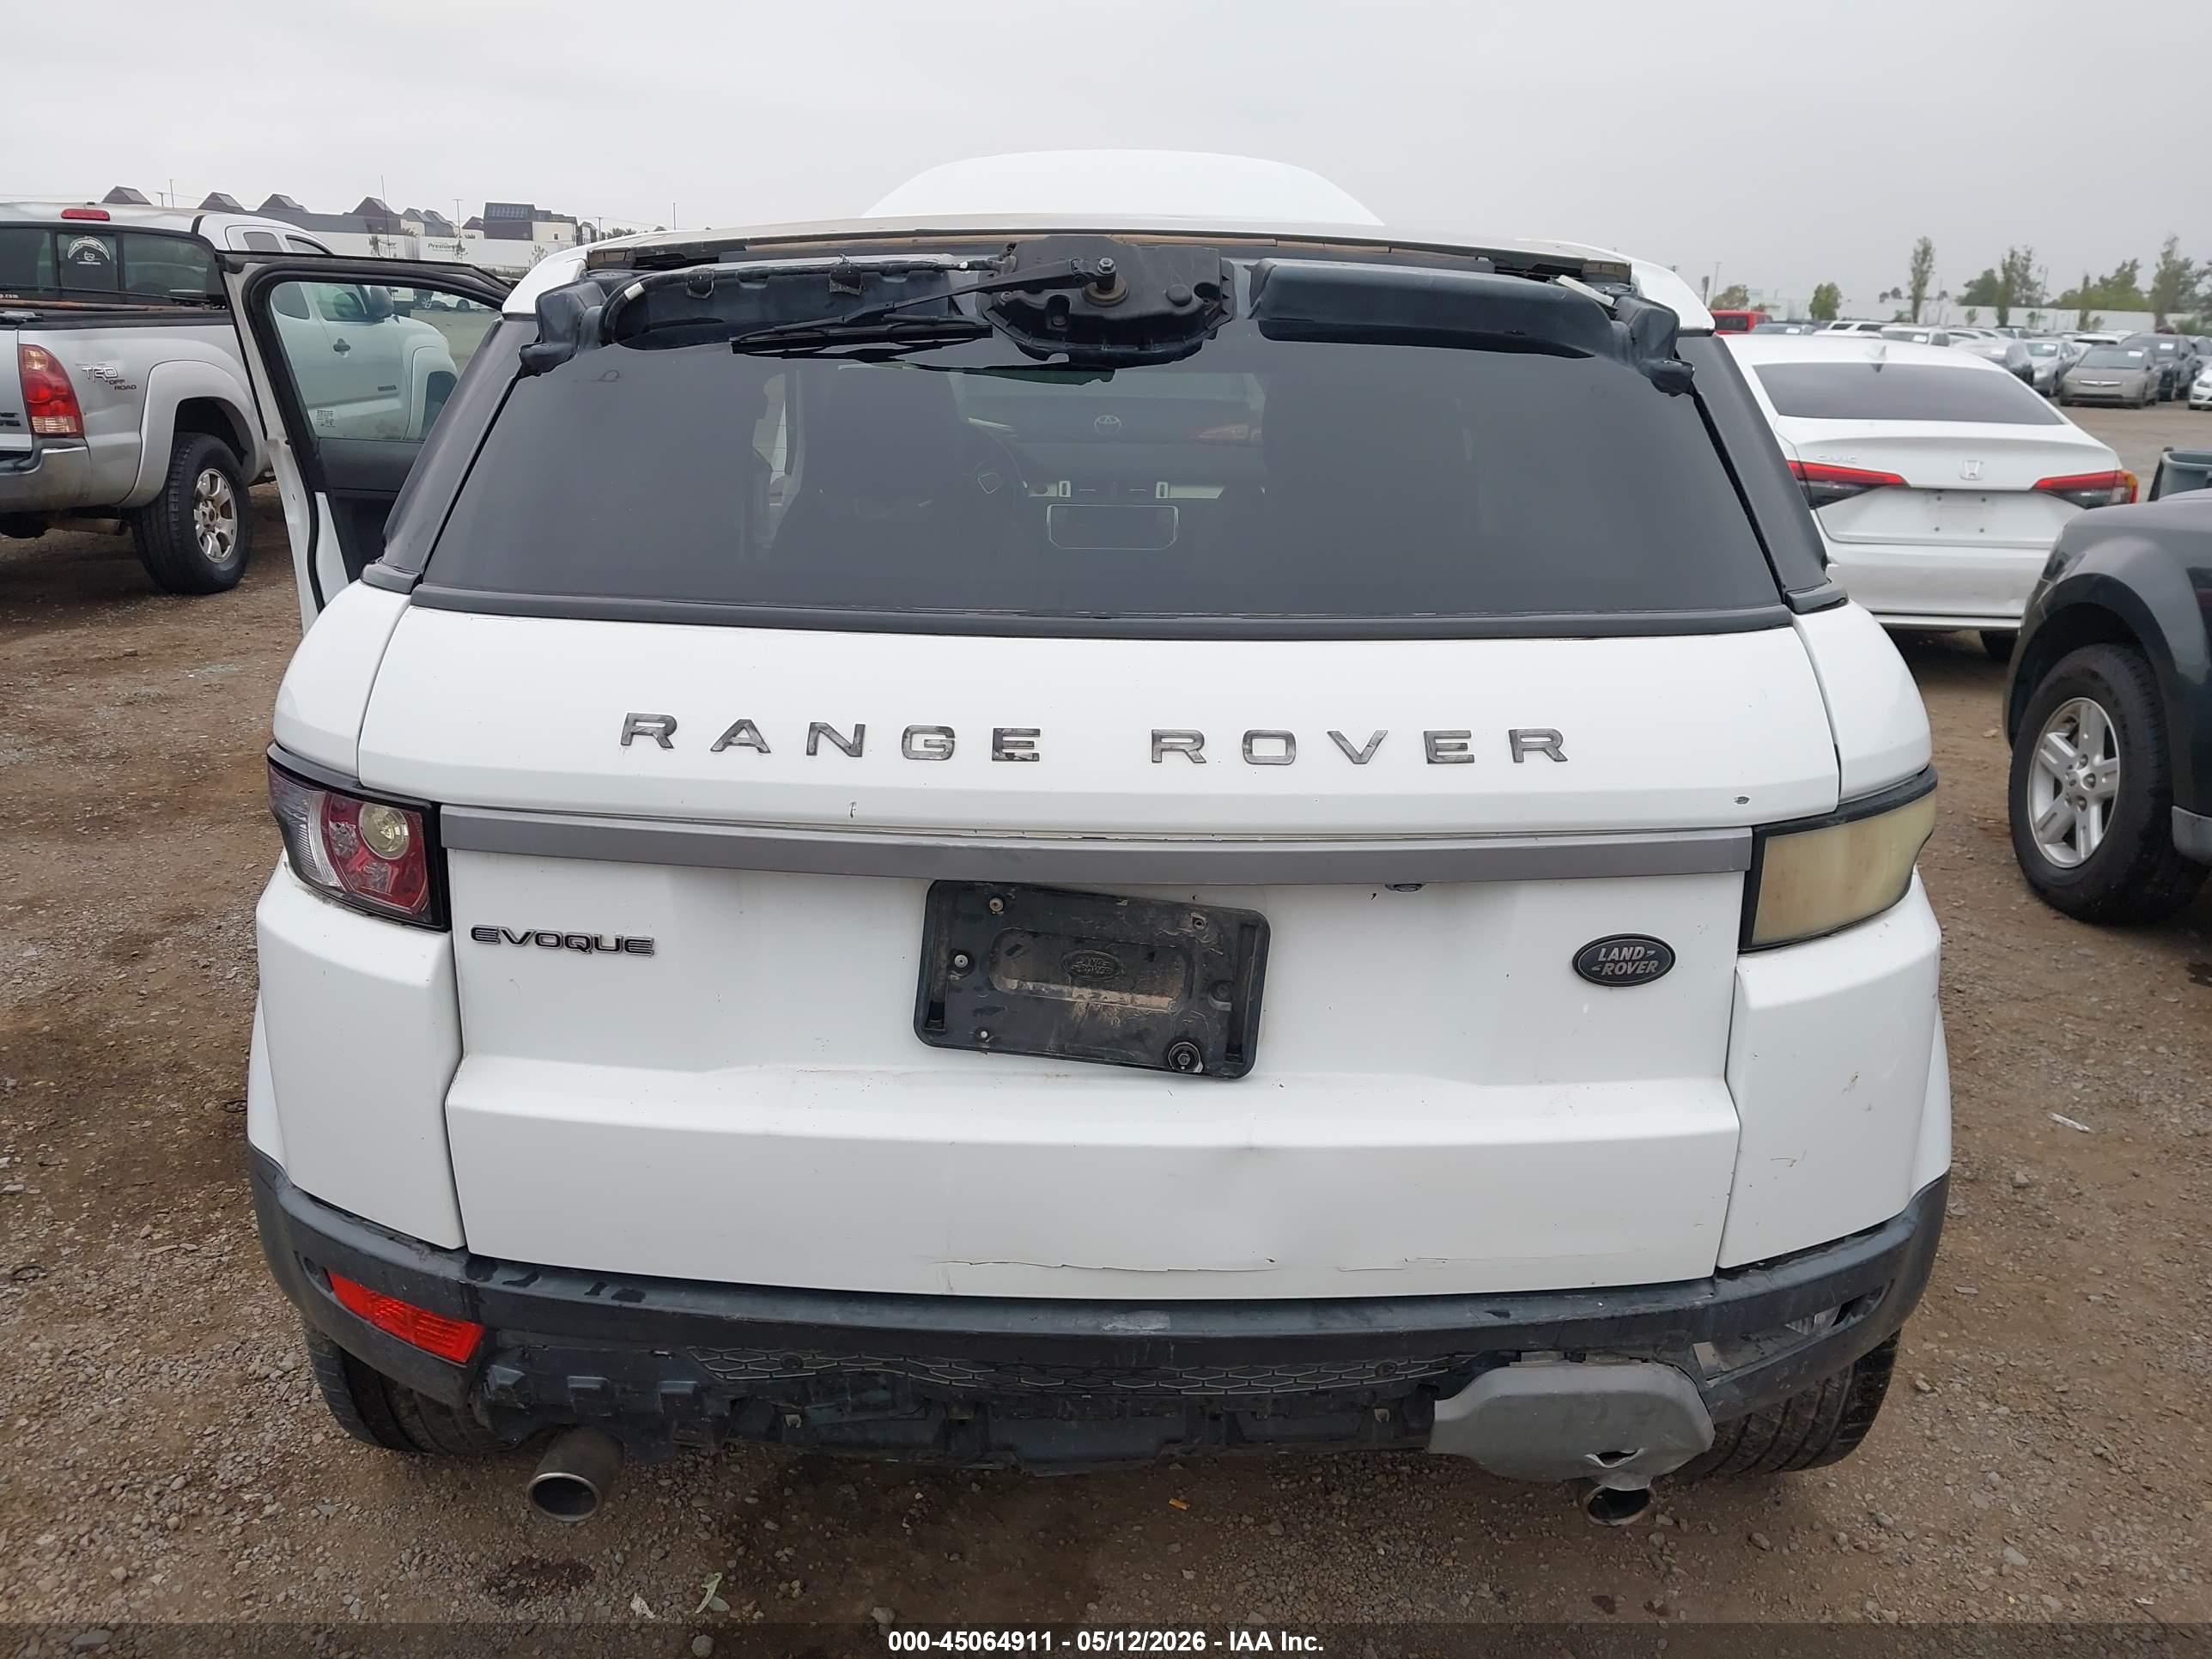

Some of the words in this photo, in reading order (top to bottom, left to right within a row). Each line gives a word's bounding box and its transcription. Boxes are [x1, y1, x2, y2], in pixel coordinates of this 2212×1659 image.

[82, 367, 118, 383] TRD
[619, 711, 1042, 763] RANGE
[1151, 727, 1569, 766] ROVER
[471, 925, 654, 957] EVOQUE
[1597, 946, 1645, 962] LAND
[1601, 960, 1659, 975] ROVER
